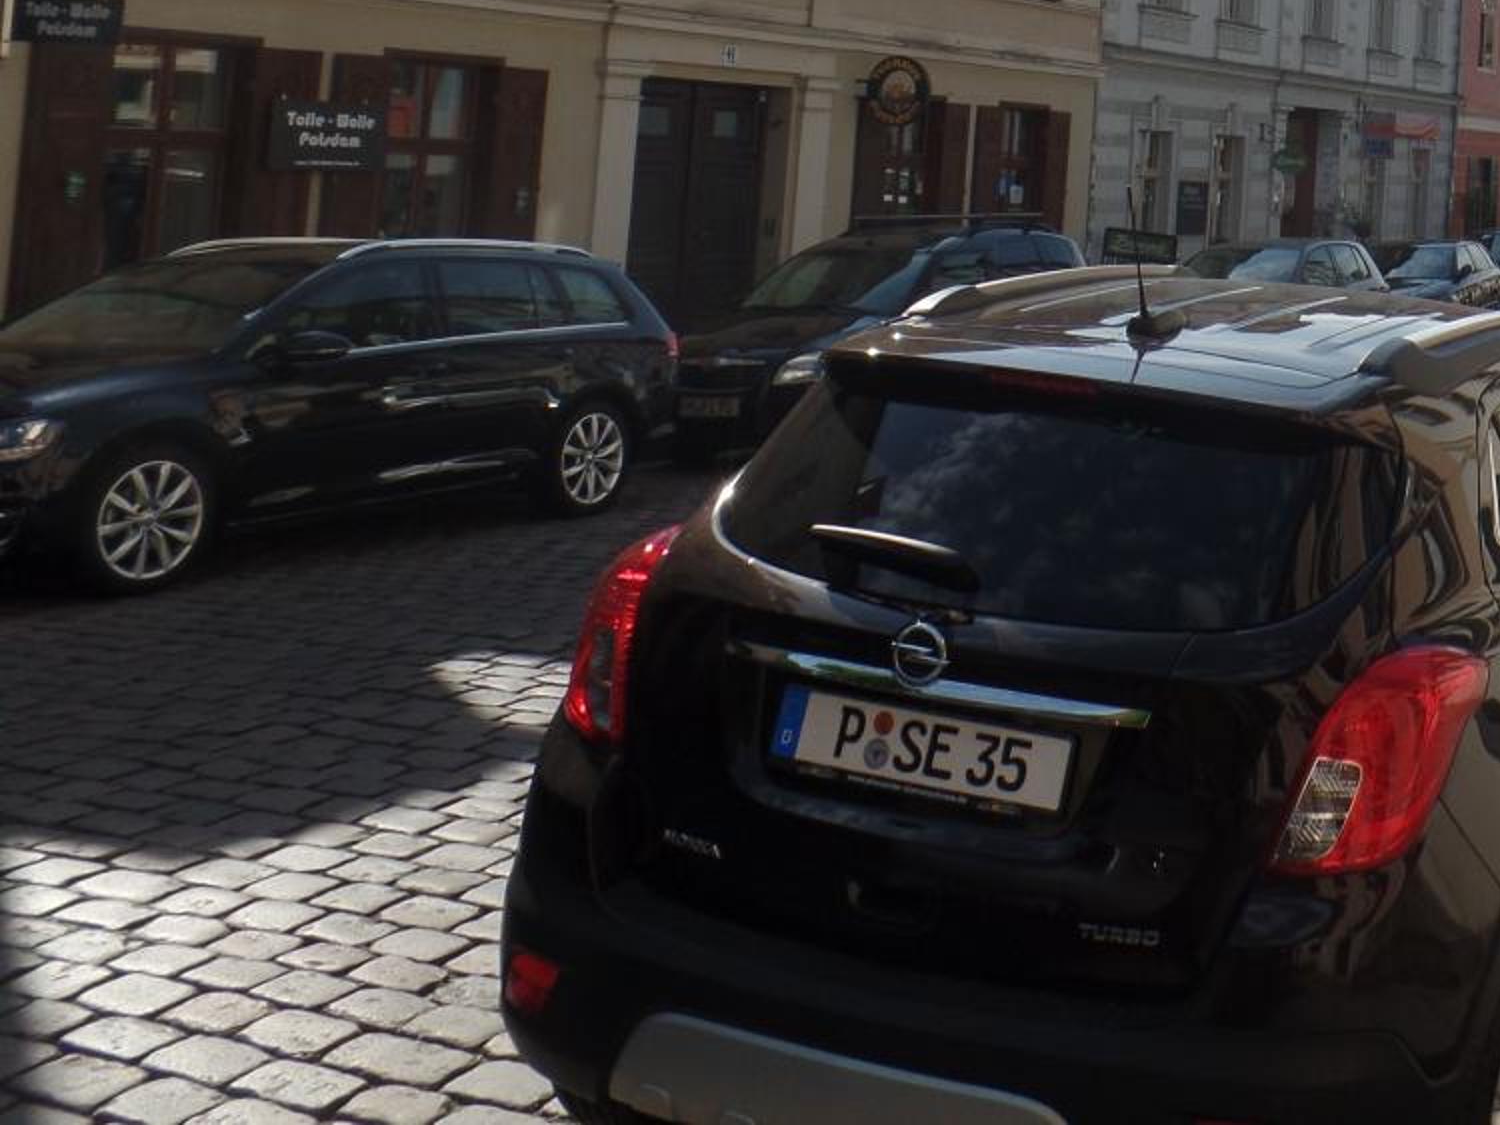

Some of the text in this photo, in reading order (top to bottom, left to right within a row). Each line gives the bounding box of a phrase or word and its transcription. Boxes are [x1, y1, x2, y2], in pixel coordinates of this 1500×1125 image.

[287, 111, 325, 127] Tolle
[299, 131, 360, 148] Potsdam
[965, 732, 1033, 793] 35
[1078, 922, 1160, 946] TURBO
